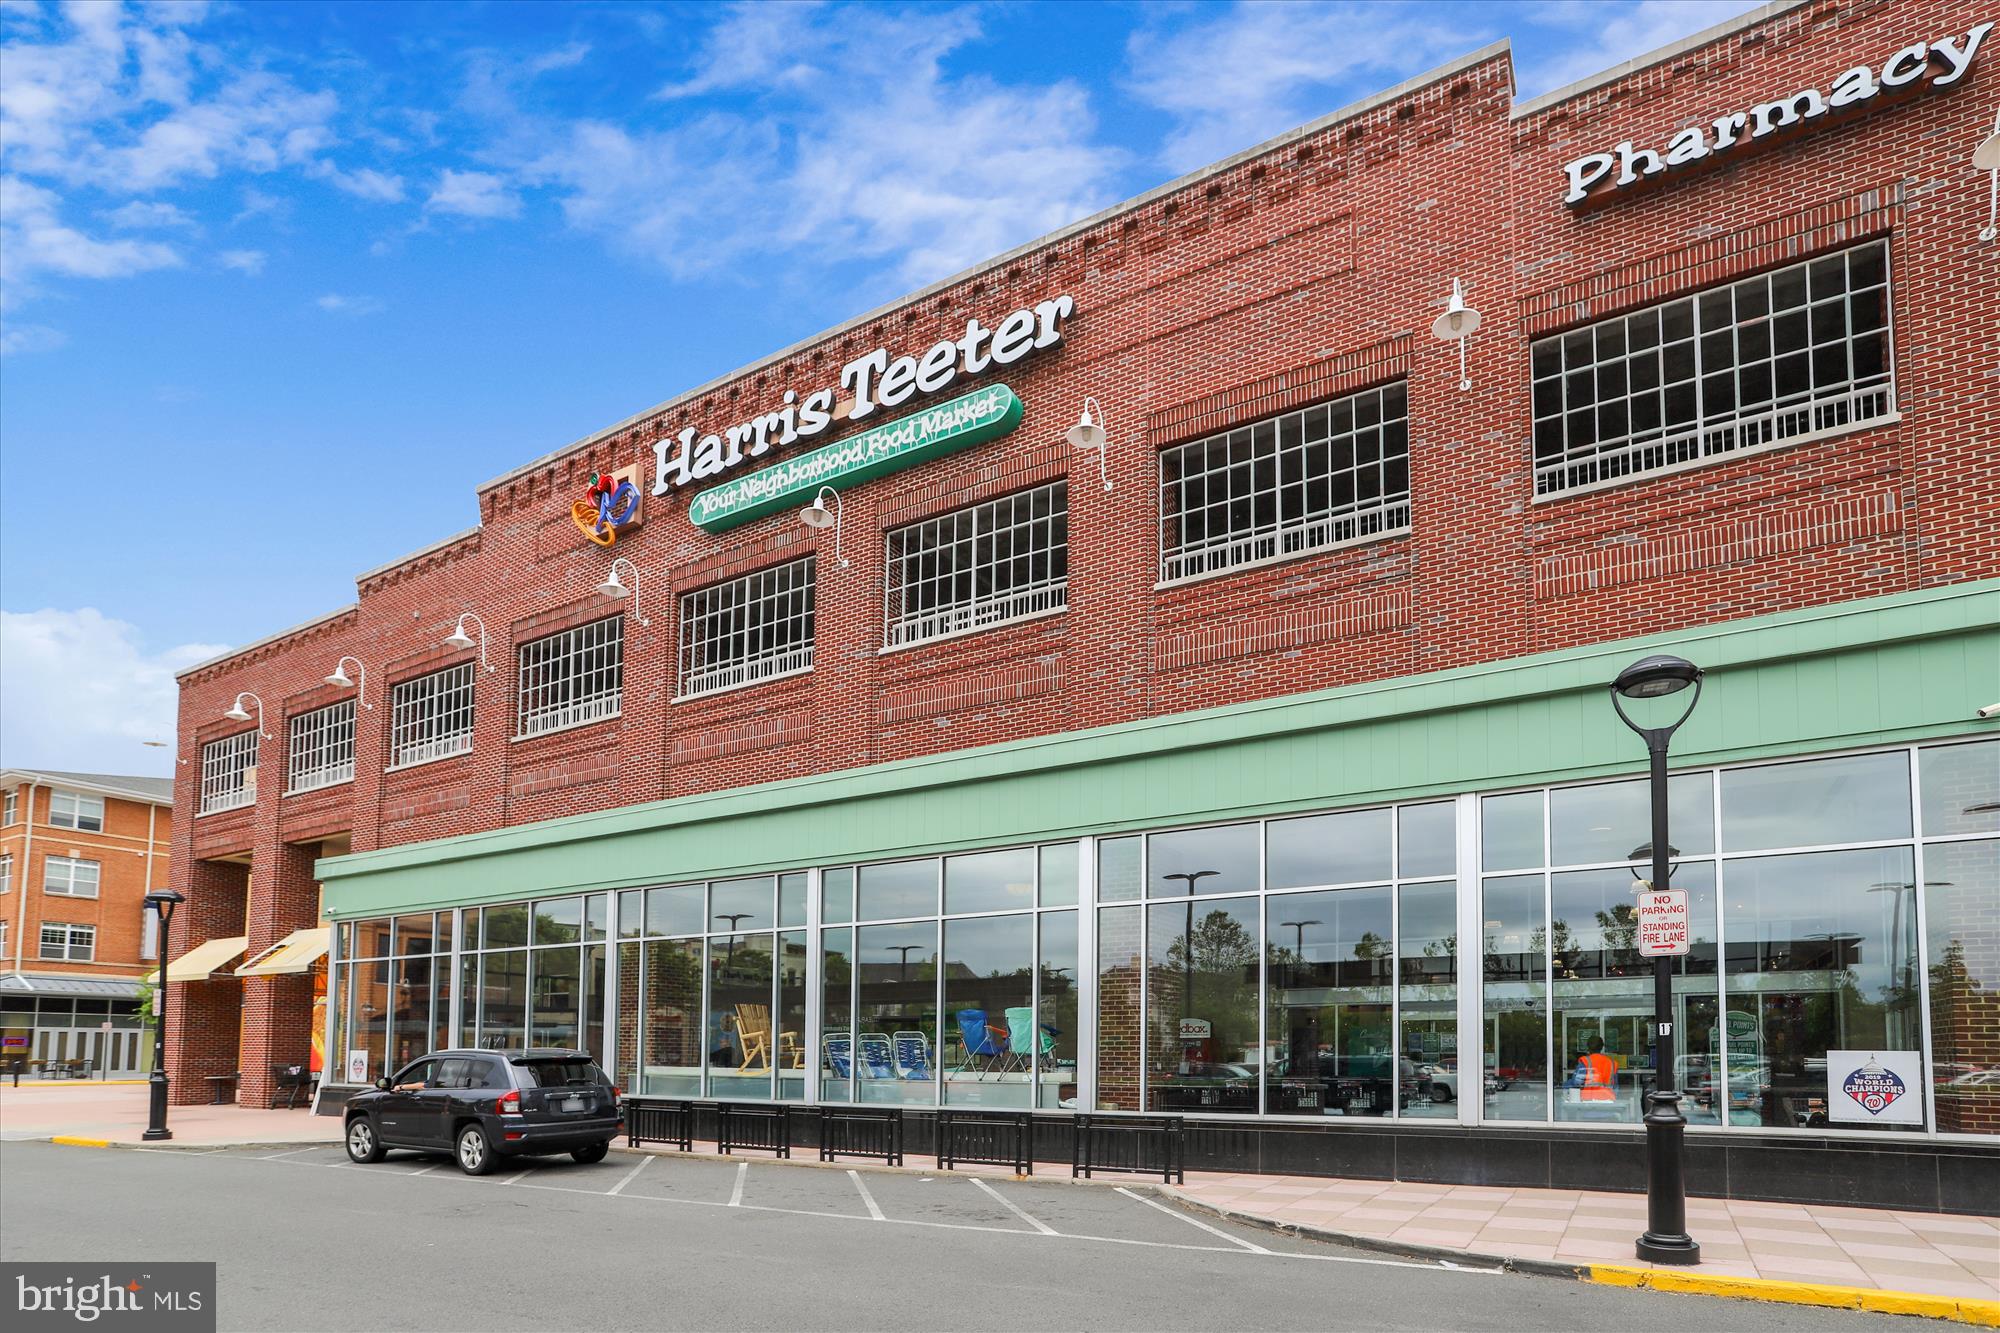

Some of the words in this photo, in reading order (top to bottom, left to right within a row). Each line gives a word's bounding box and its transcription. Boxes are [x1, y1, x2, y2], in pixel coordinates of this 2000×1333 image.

[1564, 21, 1995, 205] Pharmacy
[651, 388, 833, 497] Harris
[841, 295, 1074, 421] Teeter
[700, 488, 738, 514] Your
[740, 437, 862, 501] Neighborhood
[866, 420, 916, 456] Food
[920, 391, 998, 438] Market
[1654, 896, 1671, 904] NO
[1641, 905, 1685, 915] PARKING
[1642, 922, 1685, 932] STANDING
[1642, 933, 1661, 943] FIRE
[1664, 932, 1685, 943] LANE
[1179, 1022, 1206, 1034] dbox
[1854, 1078, 1894, 1086] WORLD
[1845, 1085, 1904, 1094] CHAMPIONS
